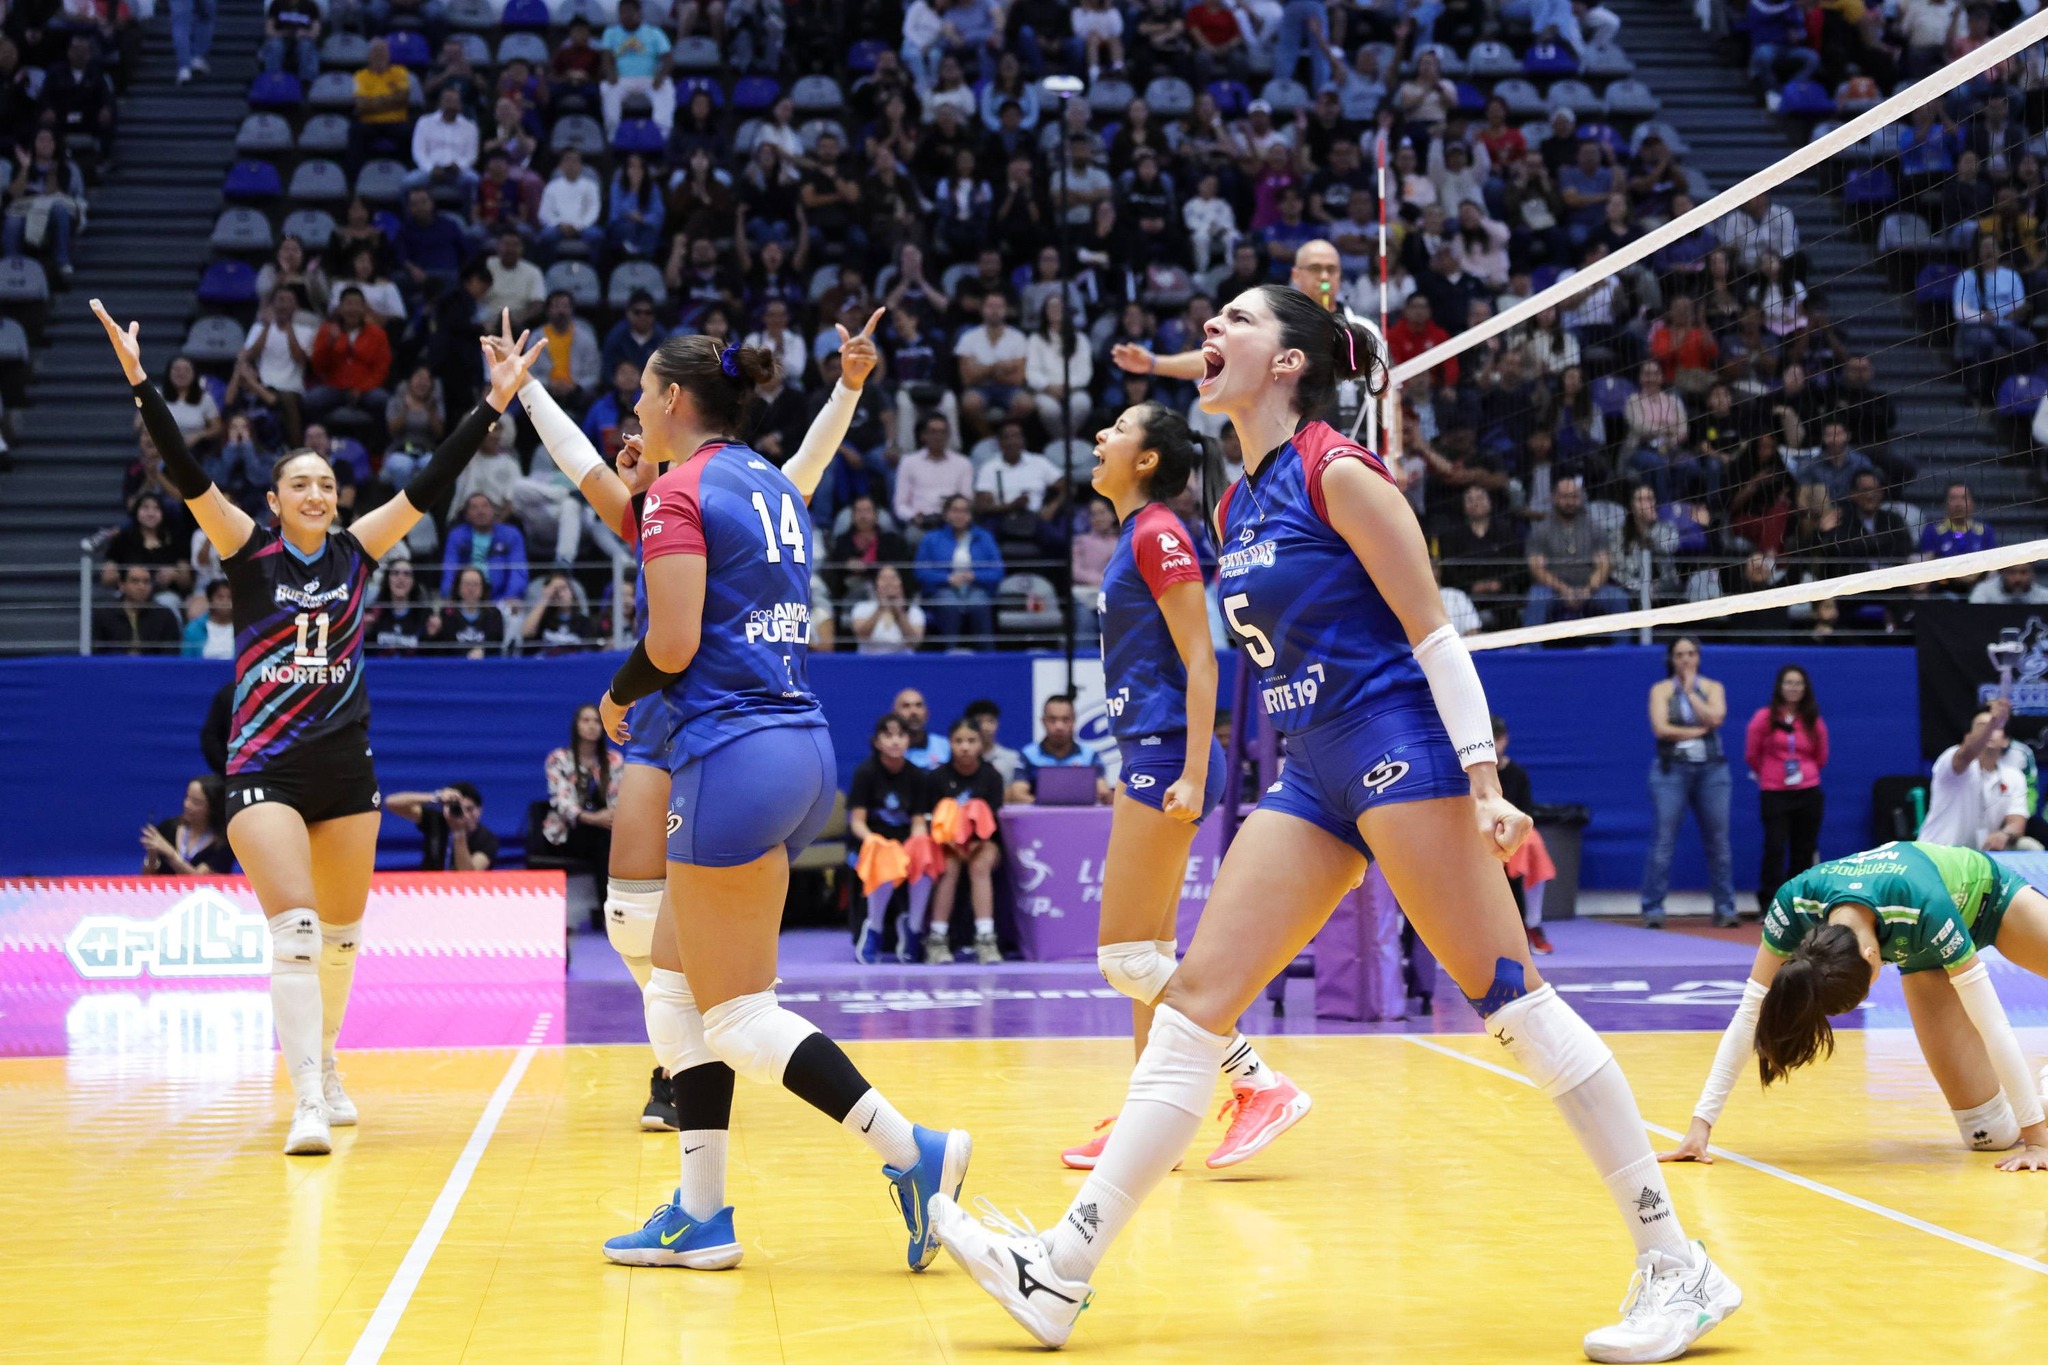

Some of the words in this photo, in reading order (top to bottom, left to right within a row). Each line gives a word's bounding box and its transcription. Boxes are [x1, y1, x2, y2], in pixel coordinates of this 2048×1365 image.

[751, 491, 806, 564] 14
[1161, 559, 1192, 572] FMVB
[750, 609, 774, 623] POR
[294, 613, 329, 657] 11
[745, 620, 811, 644] PUEL
[1223, 593, 1276, 669] 5
[261, 665, 328, 684] NORTE
[1262, 685, 1297, 715] RTE
[1930, 917, 1955, 946] TEB
[1067, 1212, 1094, 1245] luanvi
[1638, 1207, 1670, 1225] luanvi
